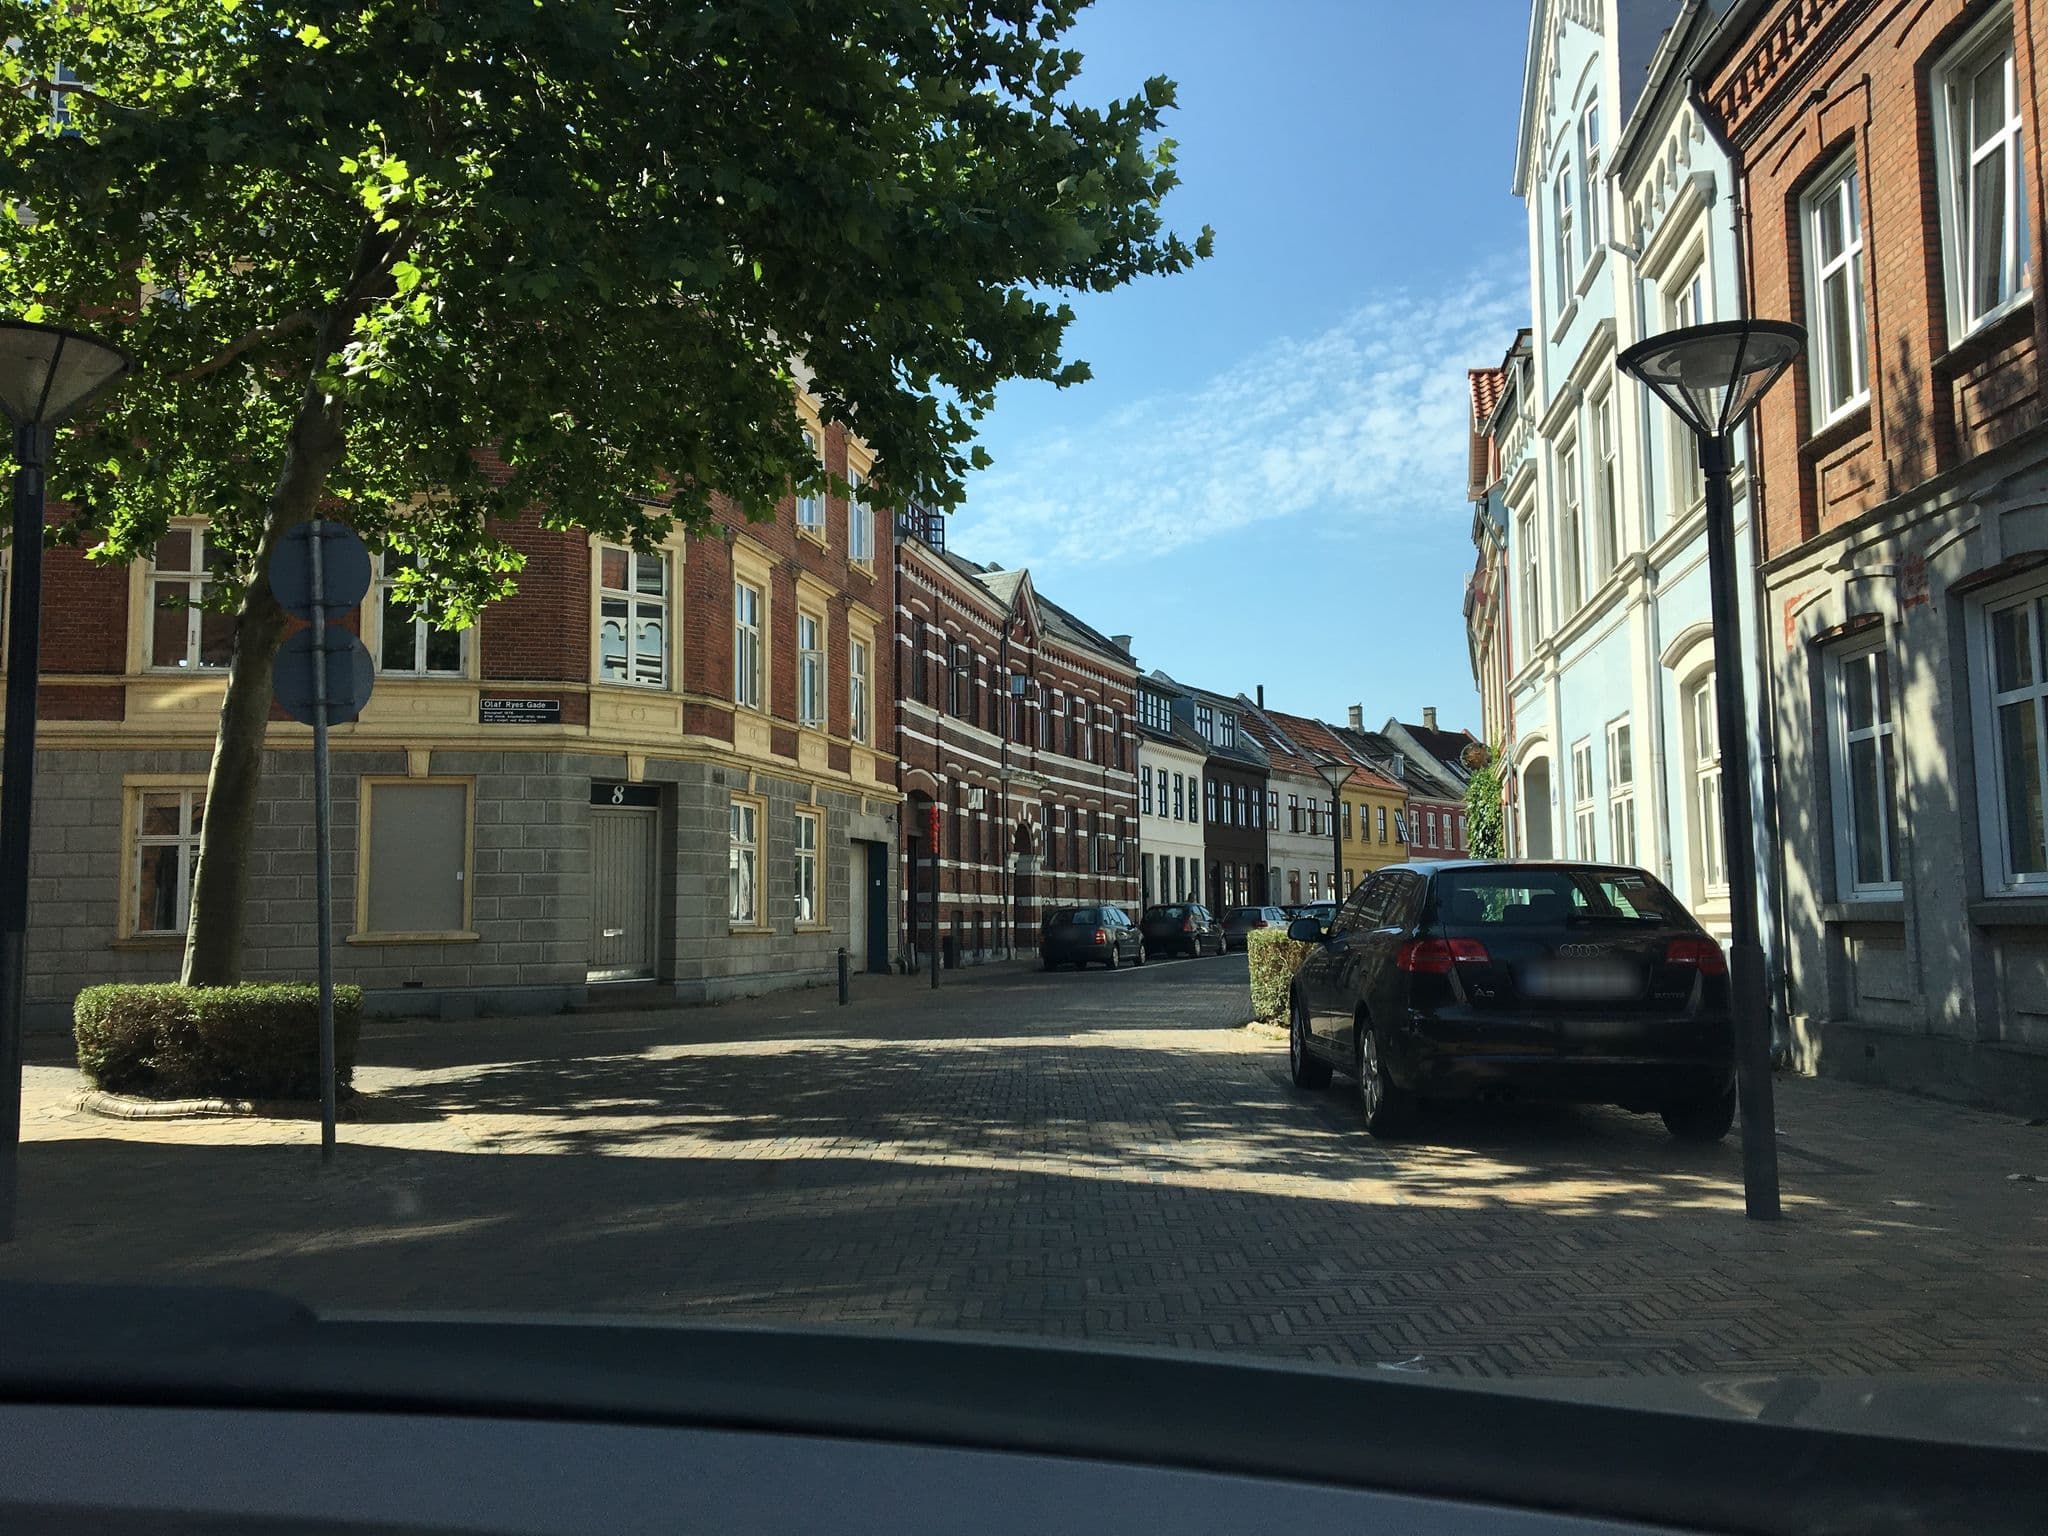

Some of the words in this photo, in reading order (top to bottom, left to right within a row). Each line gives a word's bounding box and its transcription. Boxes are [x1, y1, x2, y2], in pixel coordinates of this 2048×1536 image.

[505, 701, 524, 709] Ryes
[526, 701, 546, 709] Gade
[611, 785, 625, 805] 8
